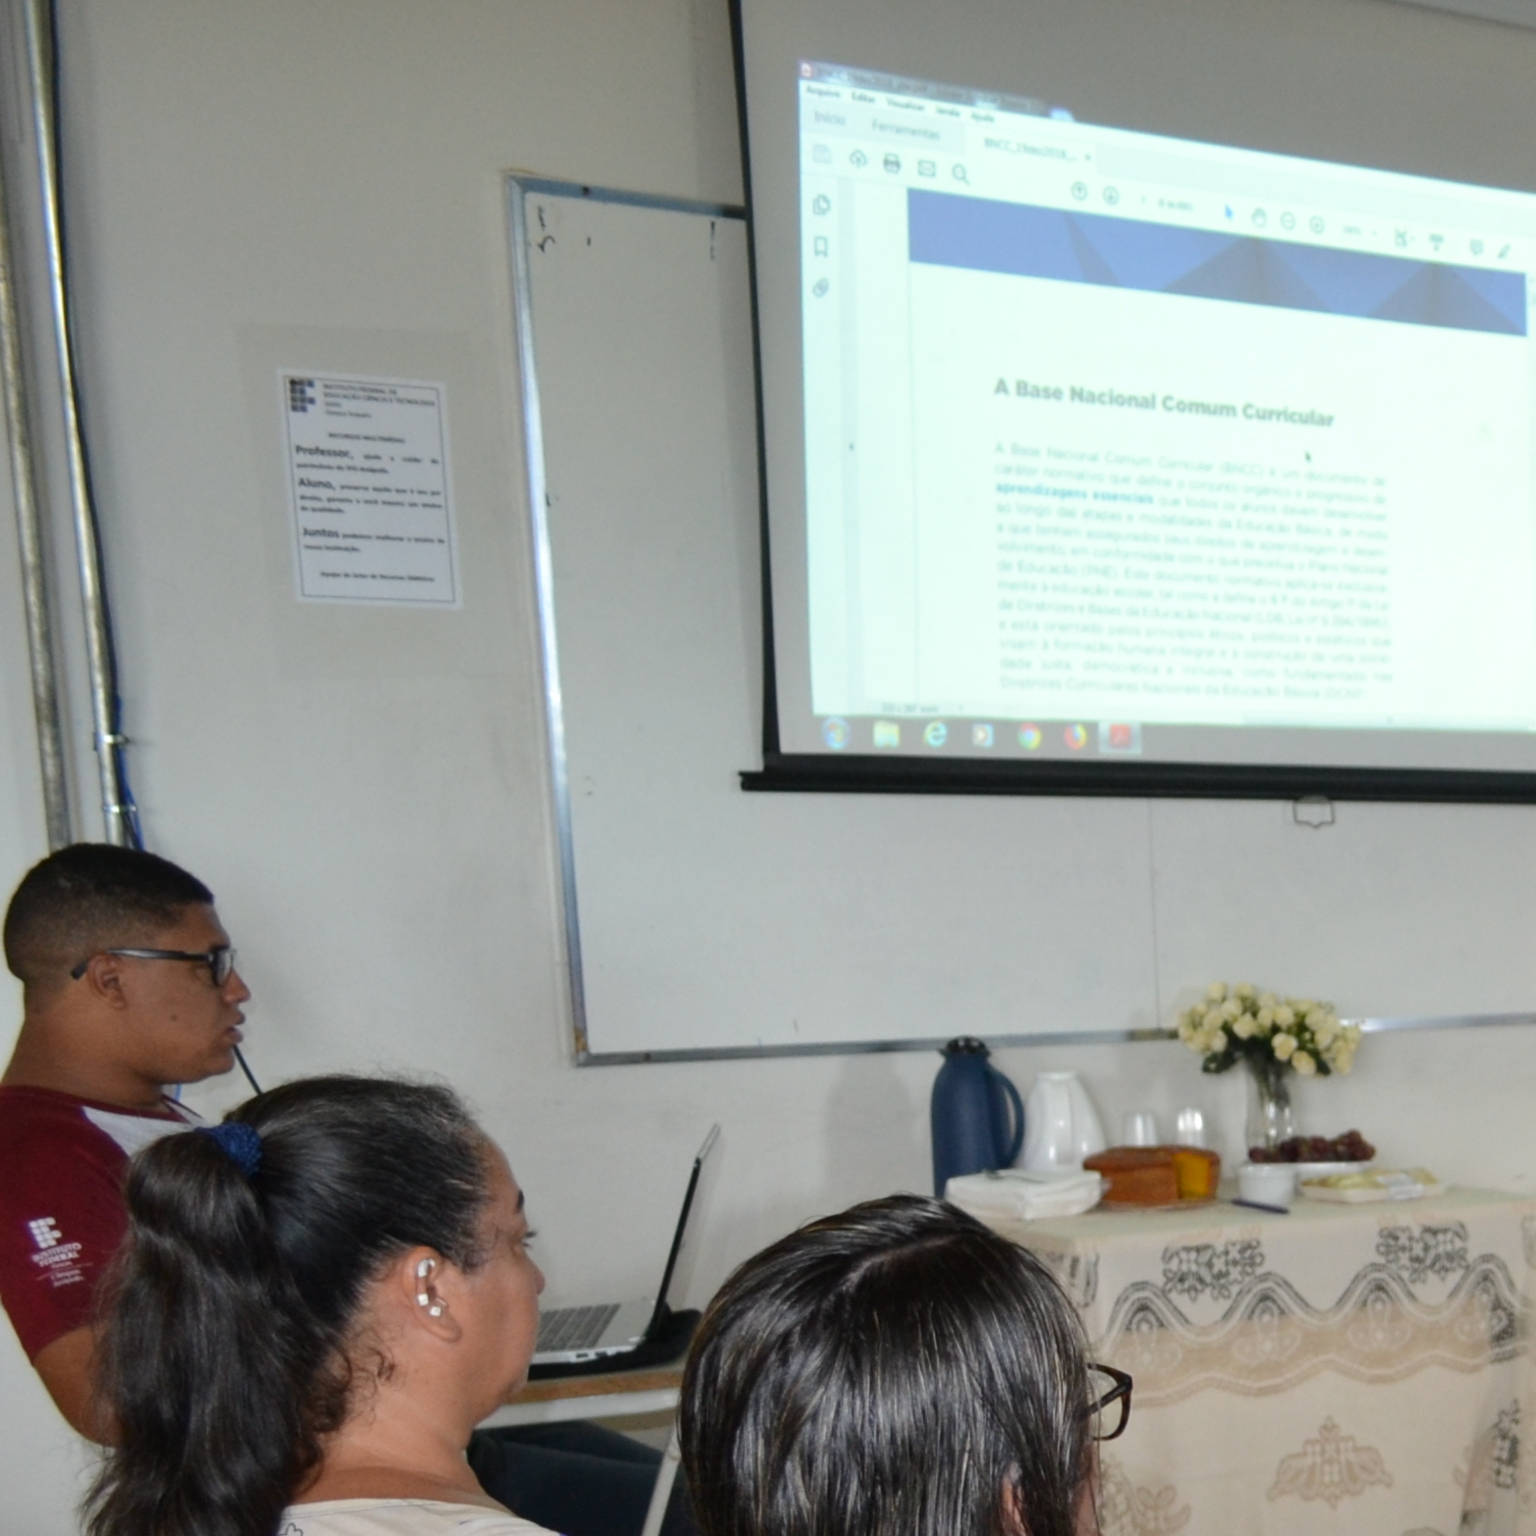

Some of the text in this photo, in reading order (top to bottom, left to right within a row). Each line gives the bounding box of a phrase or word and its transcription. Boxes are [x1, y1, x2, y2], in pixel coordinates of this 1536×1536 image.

[994, 377, 1335, 427] A Base Nacional Comum Curricular
[299, 478, 336, 490] Aluno,
[303, 527, 339, 538] Juntos
